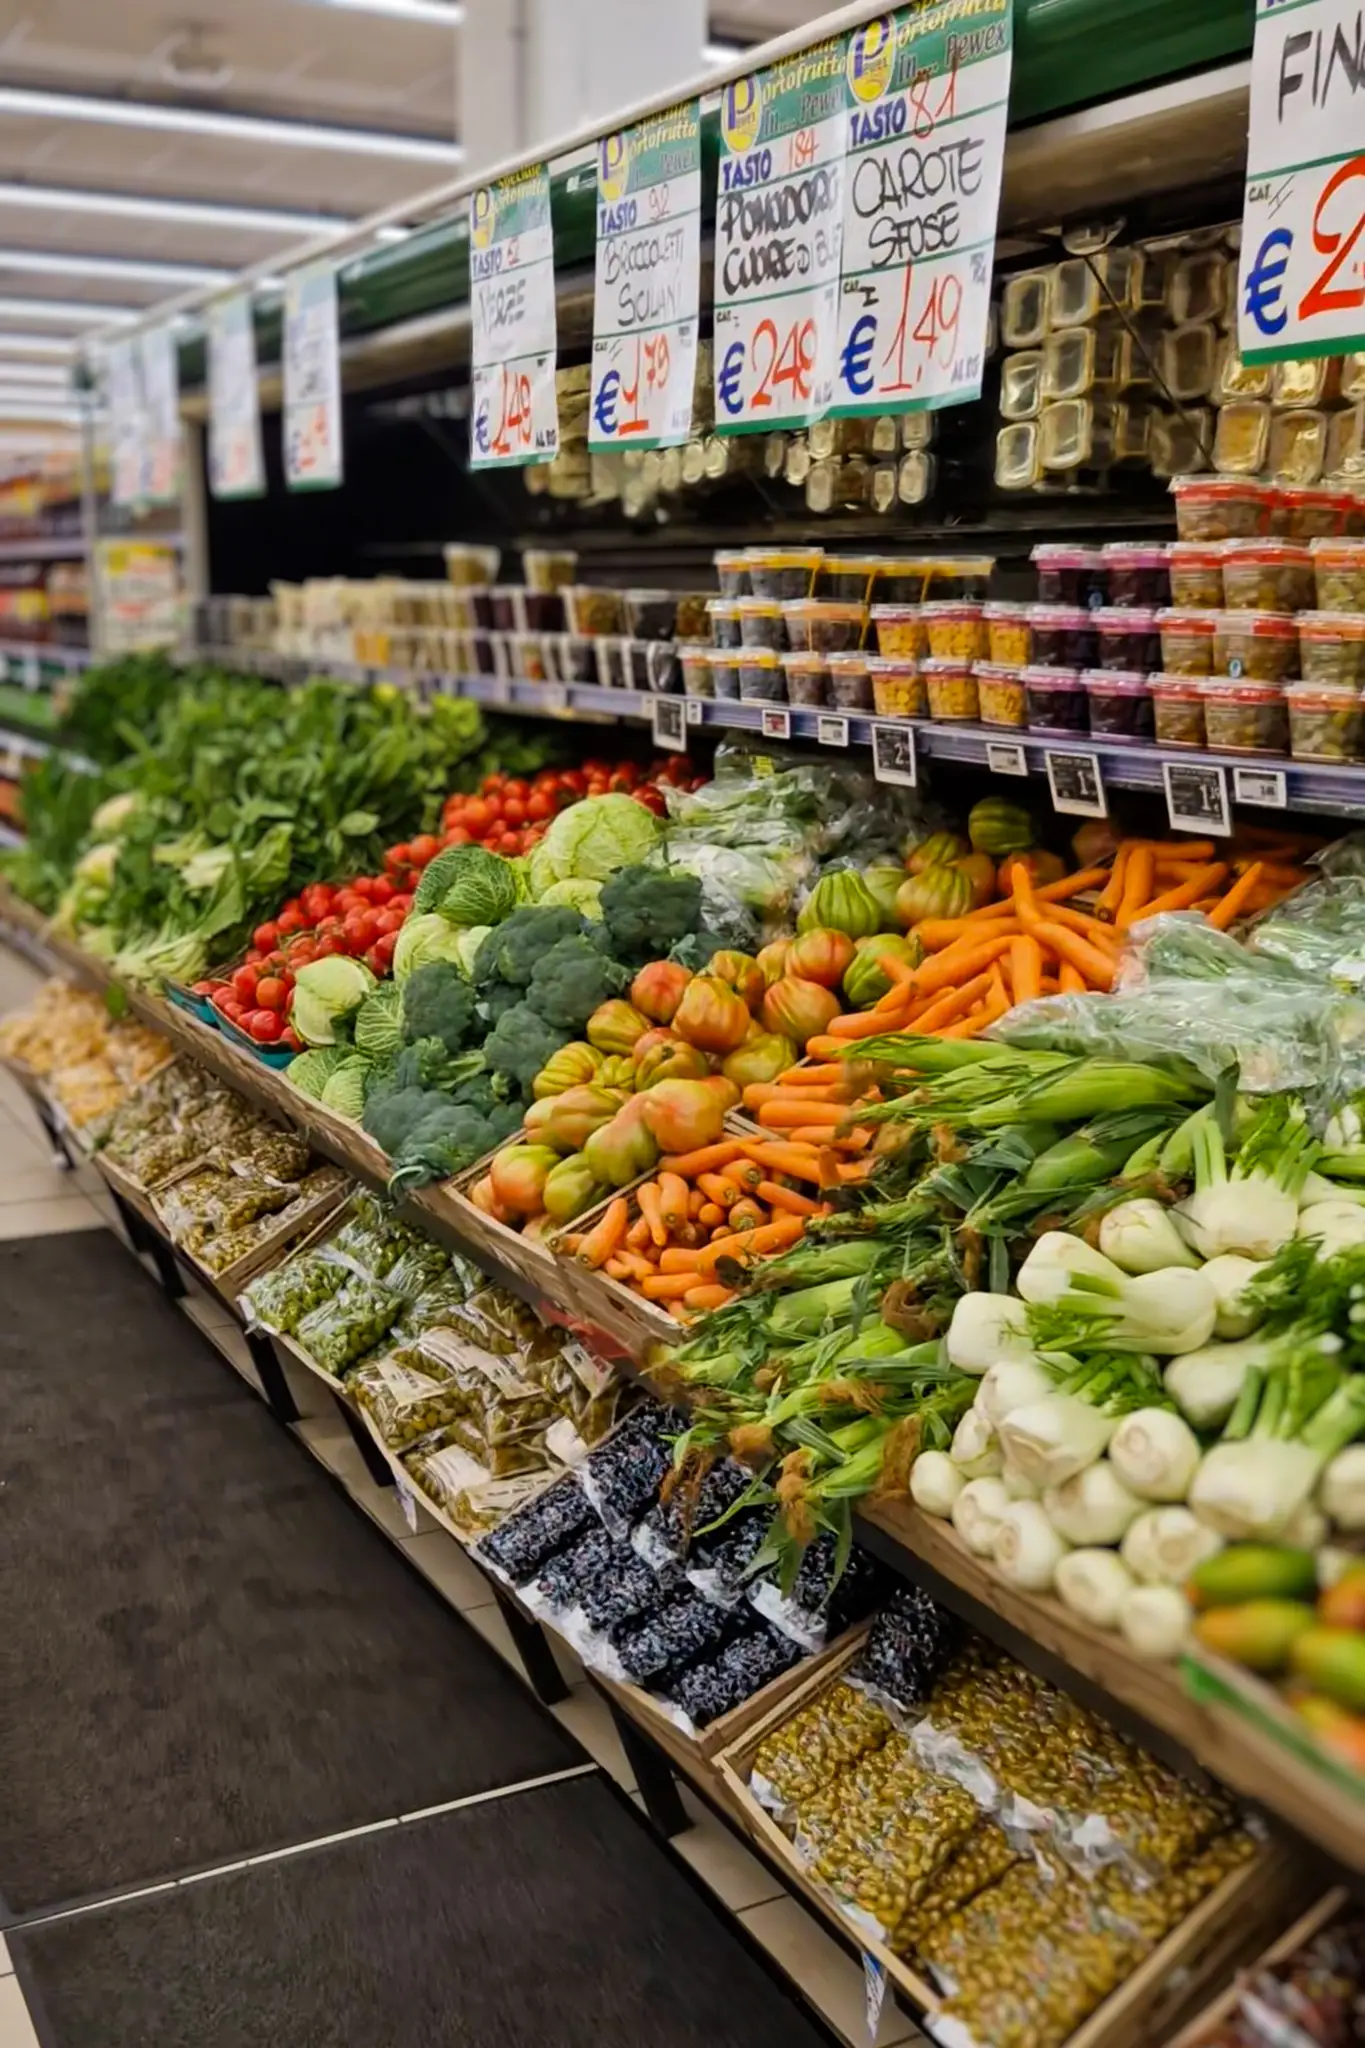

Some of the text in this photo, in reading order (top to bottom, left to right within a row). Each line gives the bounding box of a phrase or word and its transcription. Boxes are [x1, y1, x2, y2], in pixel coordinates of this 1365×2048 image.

[851, 97, 906, 146] TASTO
[911, 45, 957, 139] 81
[723, 149, 772, 190] TASTO
[852, 138, 985, 218] CAROTE
[601, 199, 637, 235] TASTO
[1244, 228, 1293, 335] €
[839, 258, 963, 395] € 1,49
[594, 369, 620, 434] €
[718, 341, 745, 414] €
